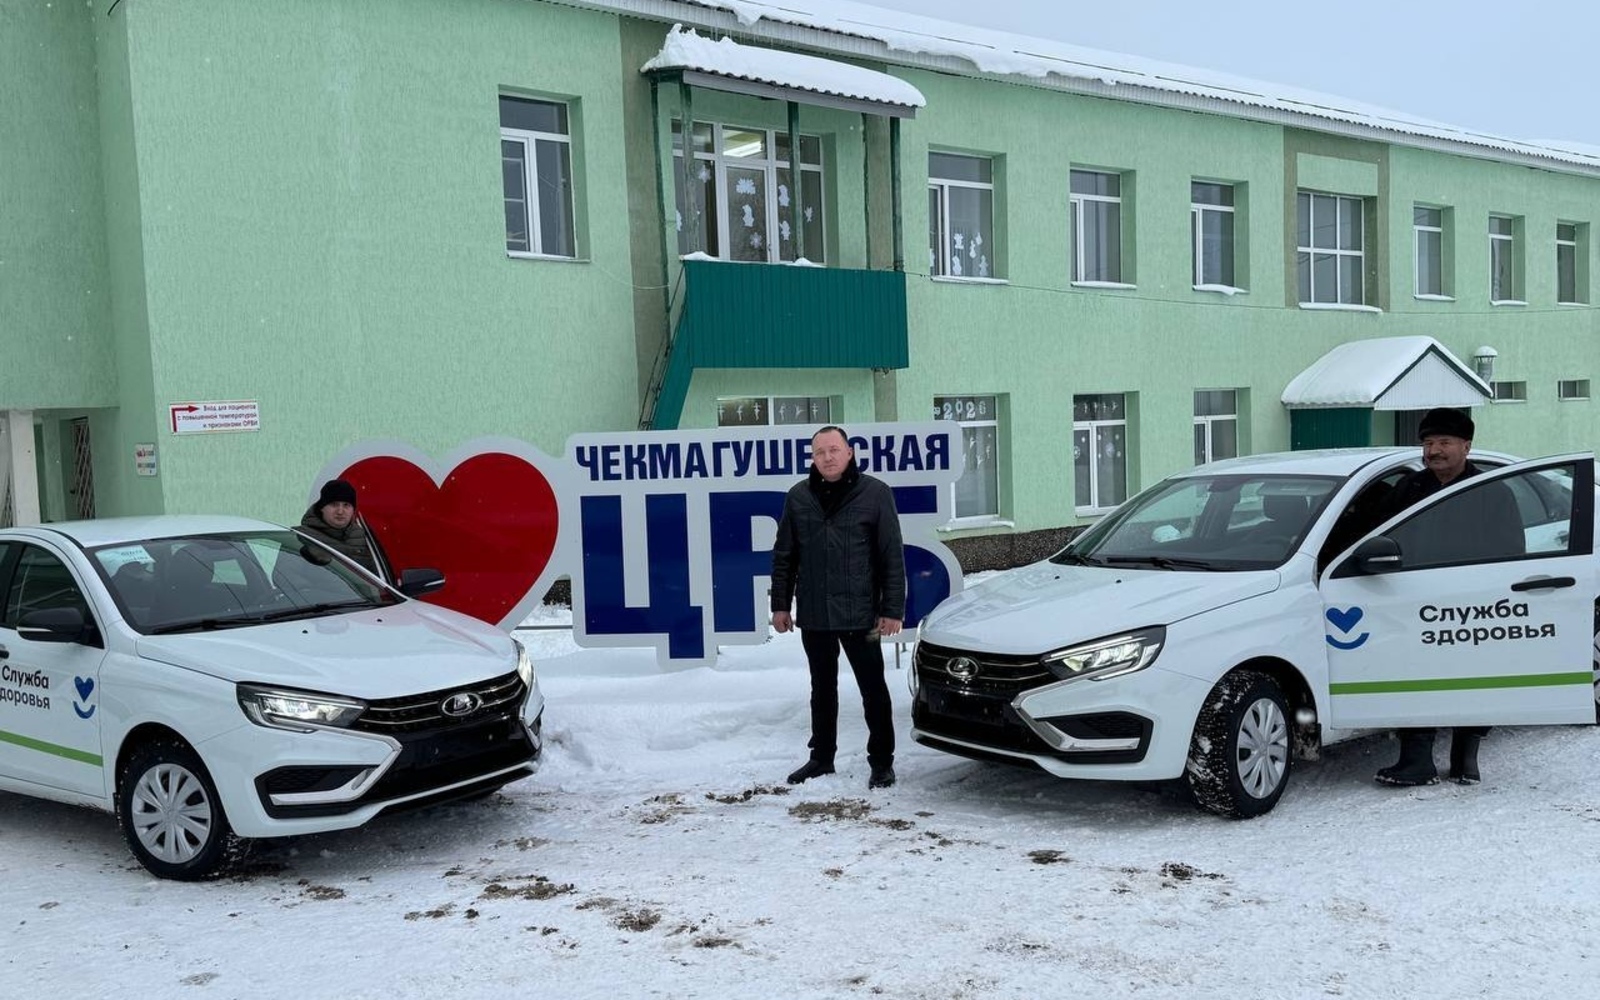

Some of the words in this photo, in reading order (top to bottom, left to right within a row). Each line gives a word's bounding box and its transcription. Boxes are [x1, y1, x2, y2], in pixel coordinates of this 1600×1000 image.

[576, 433, 950, 481] ЧЕКМАГУШЕСКАЯ
[1419, 599, 1529, 625] Служба
[1421, 623, 1556, 645] здоровья
[2, 665, 49, 689] Служба
[0, 687, 50, 710] доровья
